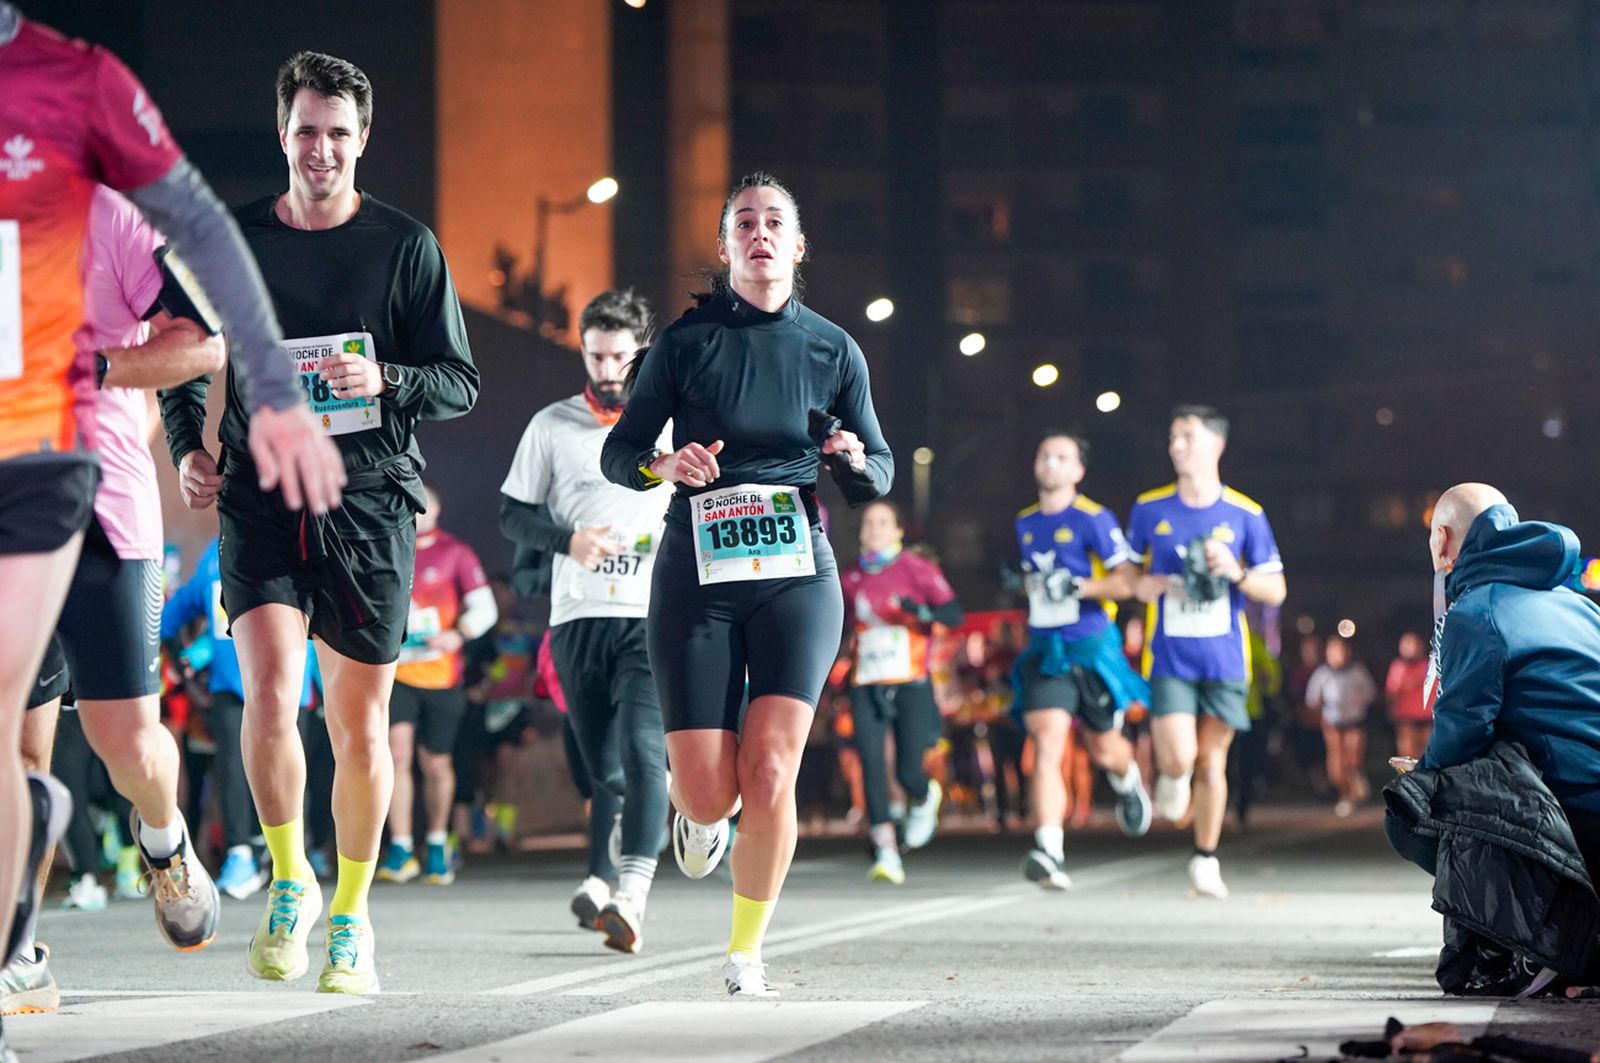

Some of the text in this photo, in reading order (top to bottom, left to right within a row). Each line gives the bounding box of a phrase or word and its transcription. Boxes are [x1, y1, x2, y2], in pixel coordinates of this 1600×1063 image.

[321, 347, 334, 358] DE
[715, 495, 748, 508] NOCHE
[750, 493, 763, 503] DE
[704, 509, 726, 522] SAN
[728, 503, 764, 518] ANTÓN
[706, 515, 796, 550] 13893
[748, 548, 761, 556] Ana
